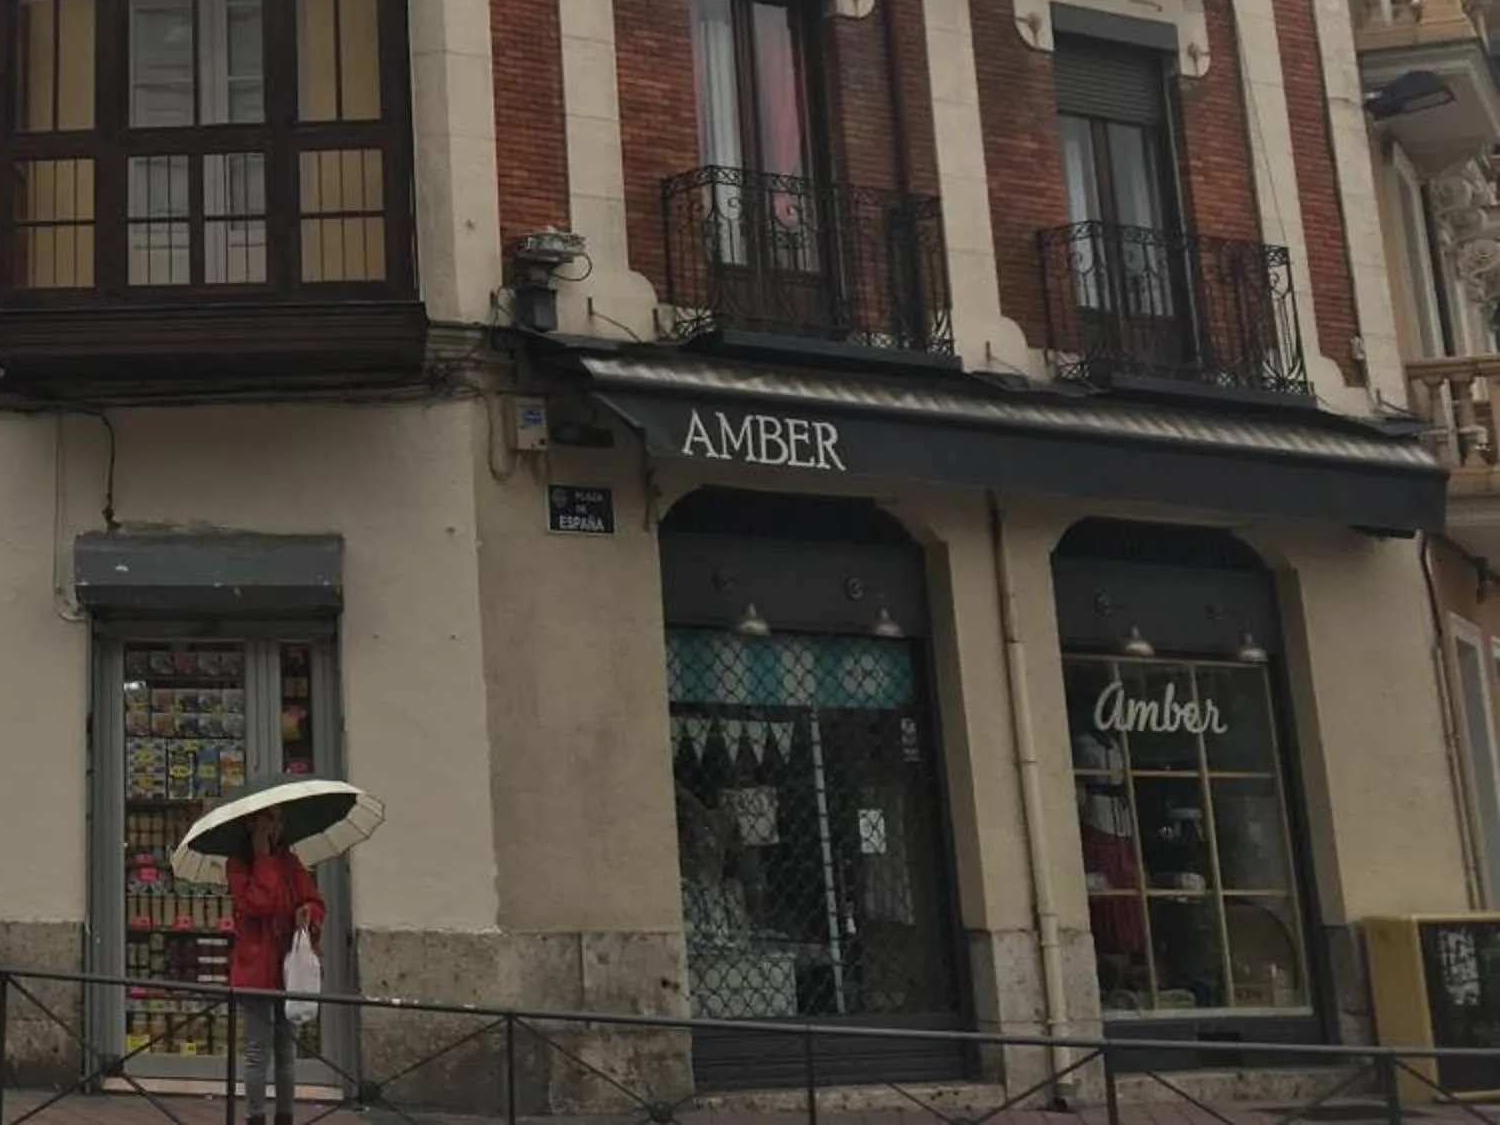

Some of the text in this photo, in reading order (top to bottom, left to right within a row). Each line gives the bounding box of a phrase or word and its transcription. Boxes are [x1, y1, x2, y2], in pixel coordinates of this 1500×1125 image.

[682, 408, 846, 471] AMBER
[575, 491, 604, 503] PLAZA
[559, 514, 605, 532] ESPAÑA
[1094, 681, 1228, 734] Amber
